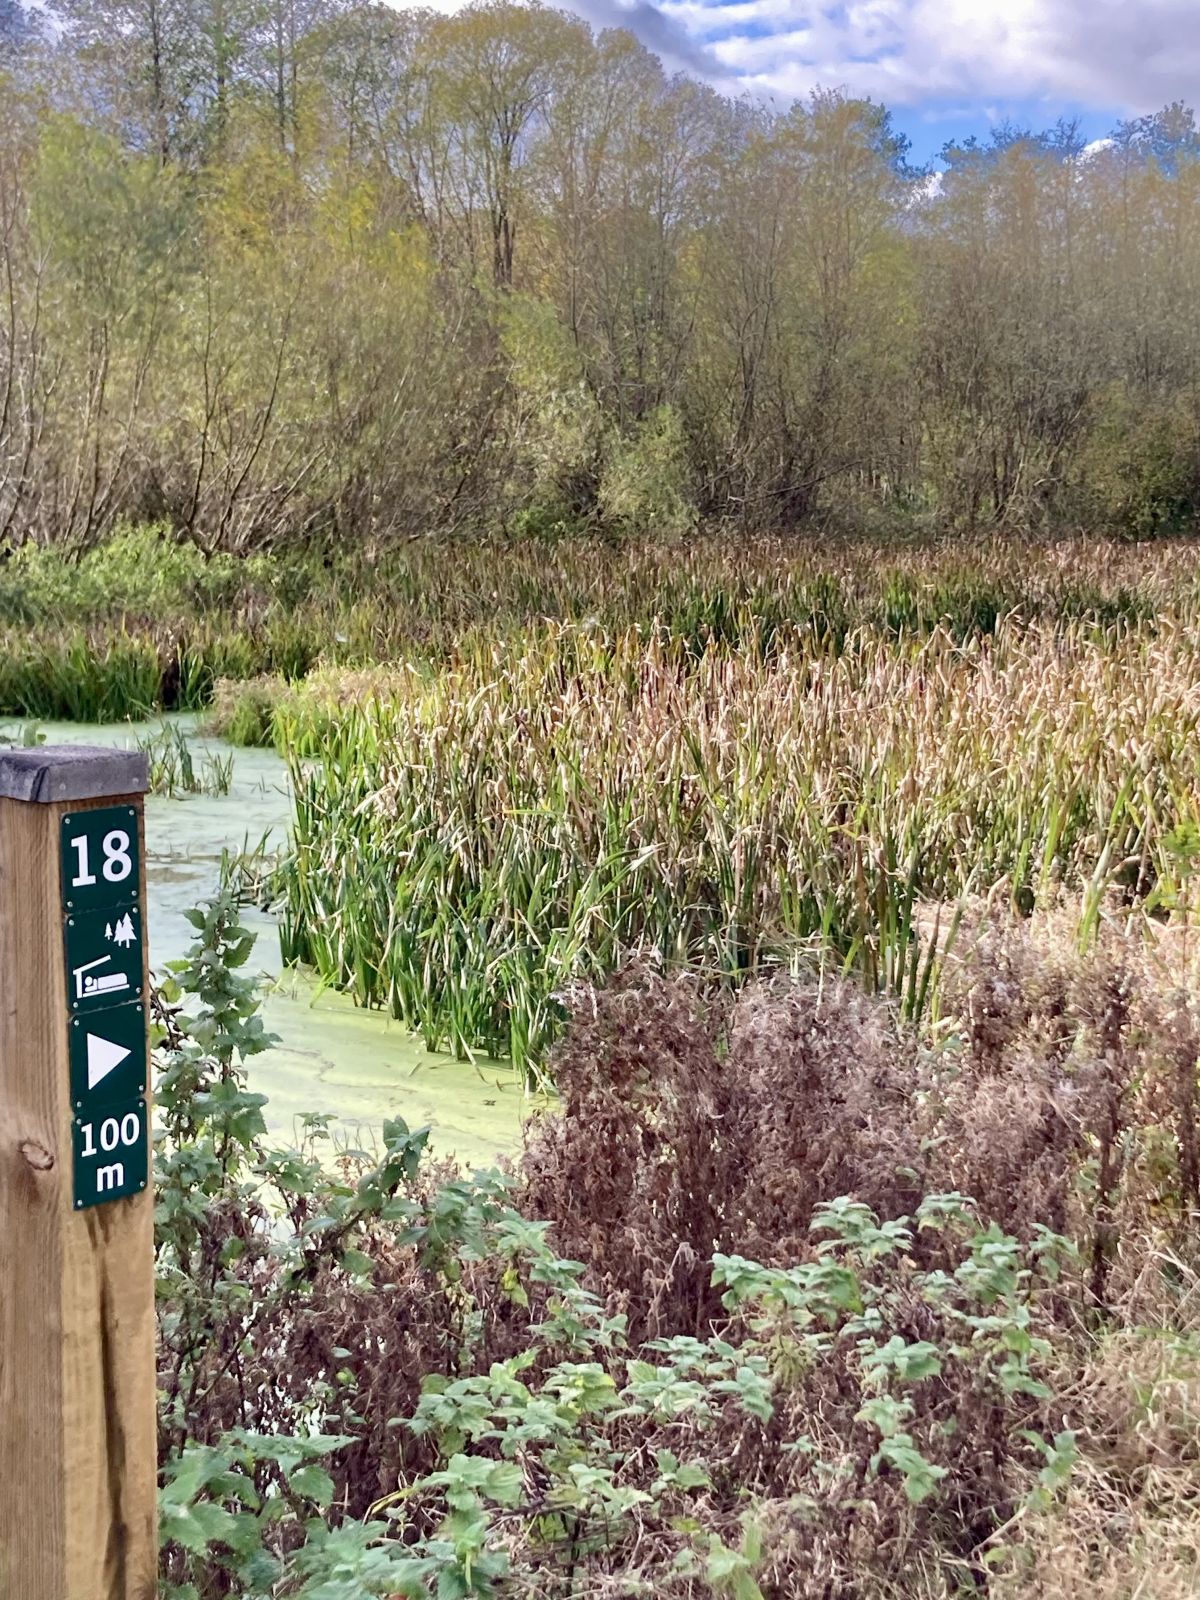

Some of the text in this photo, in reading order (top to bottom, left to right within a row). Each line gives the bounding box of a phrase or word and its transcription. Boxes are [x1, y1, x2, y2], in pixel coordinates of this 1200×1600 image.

[70, 830, 132, 887] 18
[80, 1112, 140, 1157] 100
[96, 1162, 124, 1192] m
